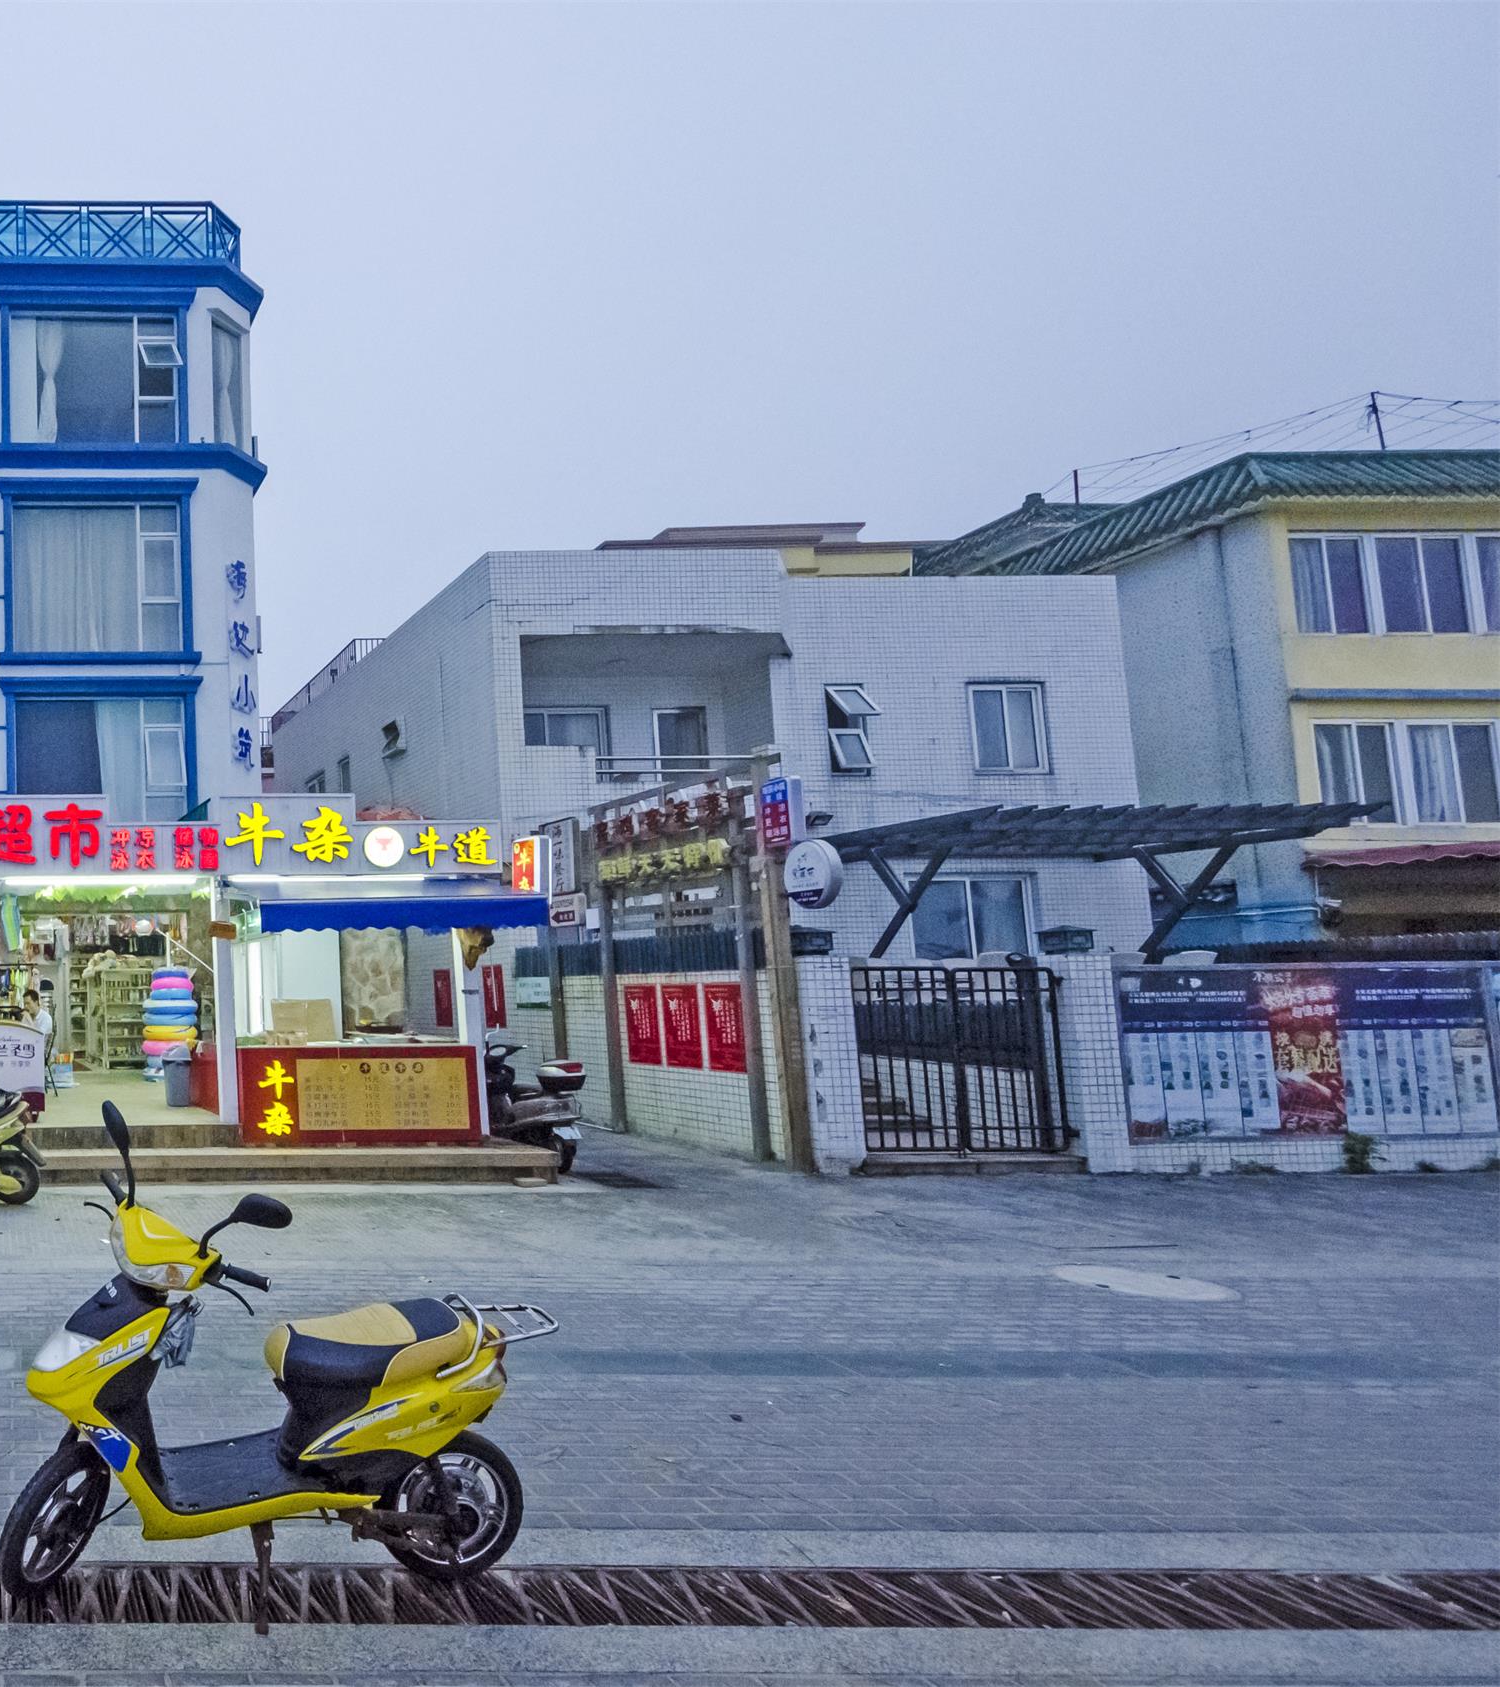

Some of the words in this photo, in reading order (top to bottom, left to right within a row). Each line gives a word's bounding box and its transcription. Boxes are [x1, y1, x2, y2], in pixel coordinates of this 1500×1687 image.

[225, 802, 354, 867] 牛杂
[409, 826, 498, 868] 牛道
[257, 1060, 295, 1136] 牛杂
